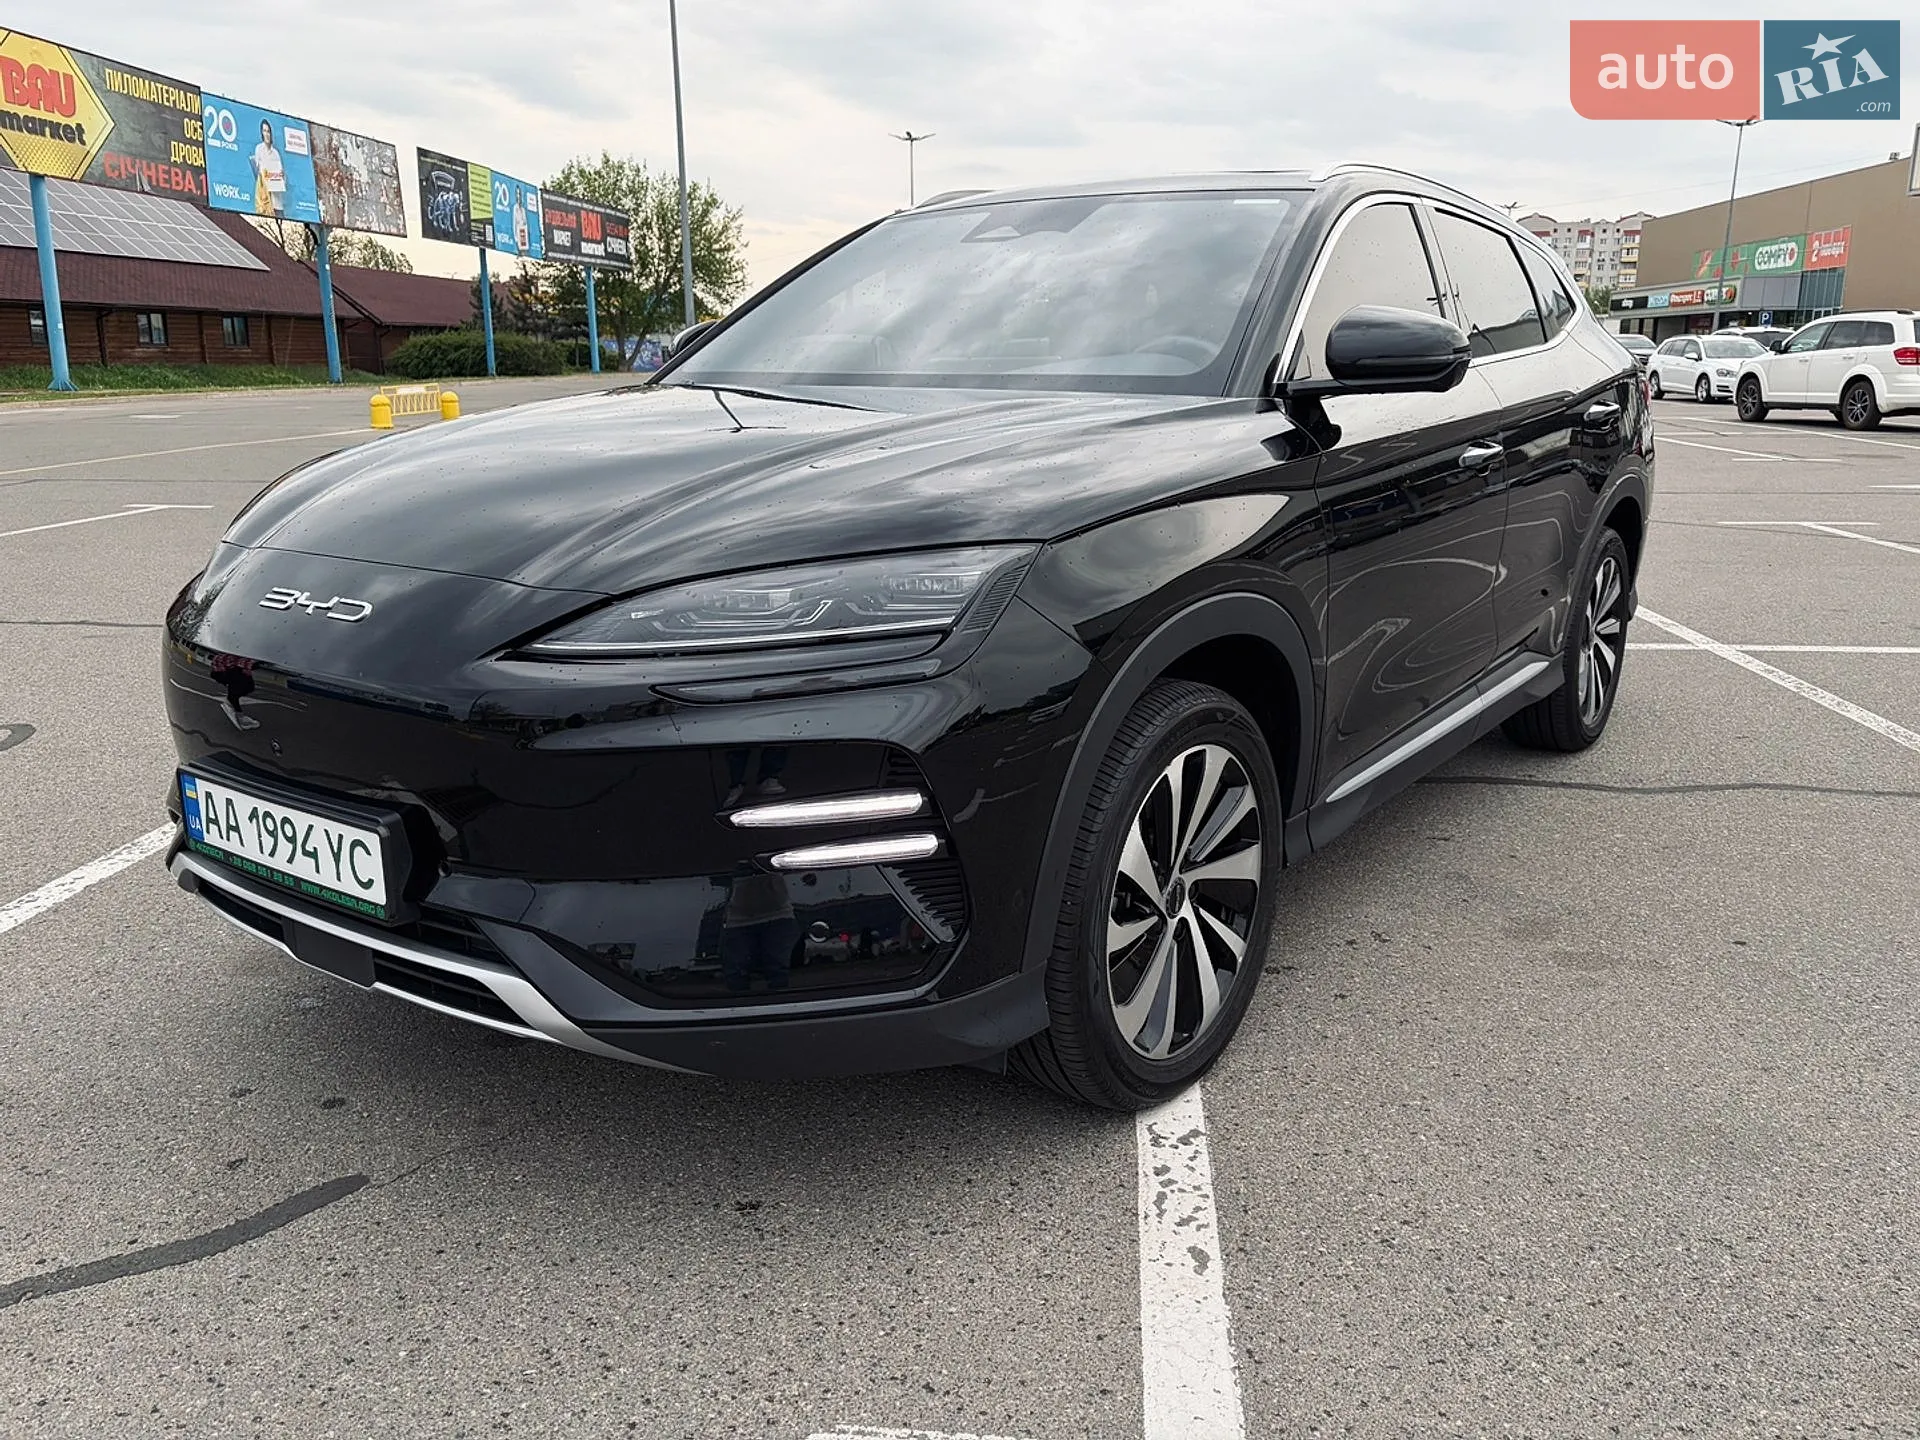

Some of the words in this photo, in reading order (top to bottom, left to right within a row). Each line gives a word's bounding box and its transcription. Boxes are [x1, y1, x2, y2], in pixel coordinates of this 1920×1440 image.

[0, 55, 76, 118] BAU
[105, 68, 201, 115] ПИЛОМАТЕРІАЛИ
[0, 109, 86, 146] market
[183, 118, 203, 141] ОСБ
[204, 105, 237, 142] 20
[170, 140, 205, 168] ДРОВА
[495, 181, 509, 206] 20
[581, 210, 602, 240] BAU
[1756, 245, 1791, 268] COMFY
[259, 587, 372, 621] BYD
[189, 814, 203, 831] UA
